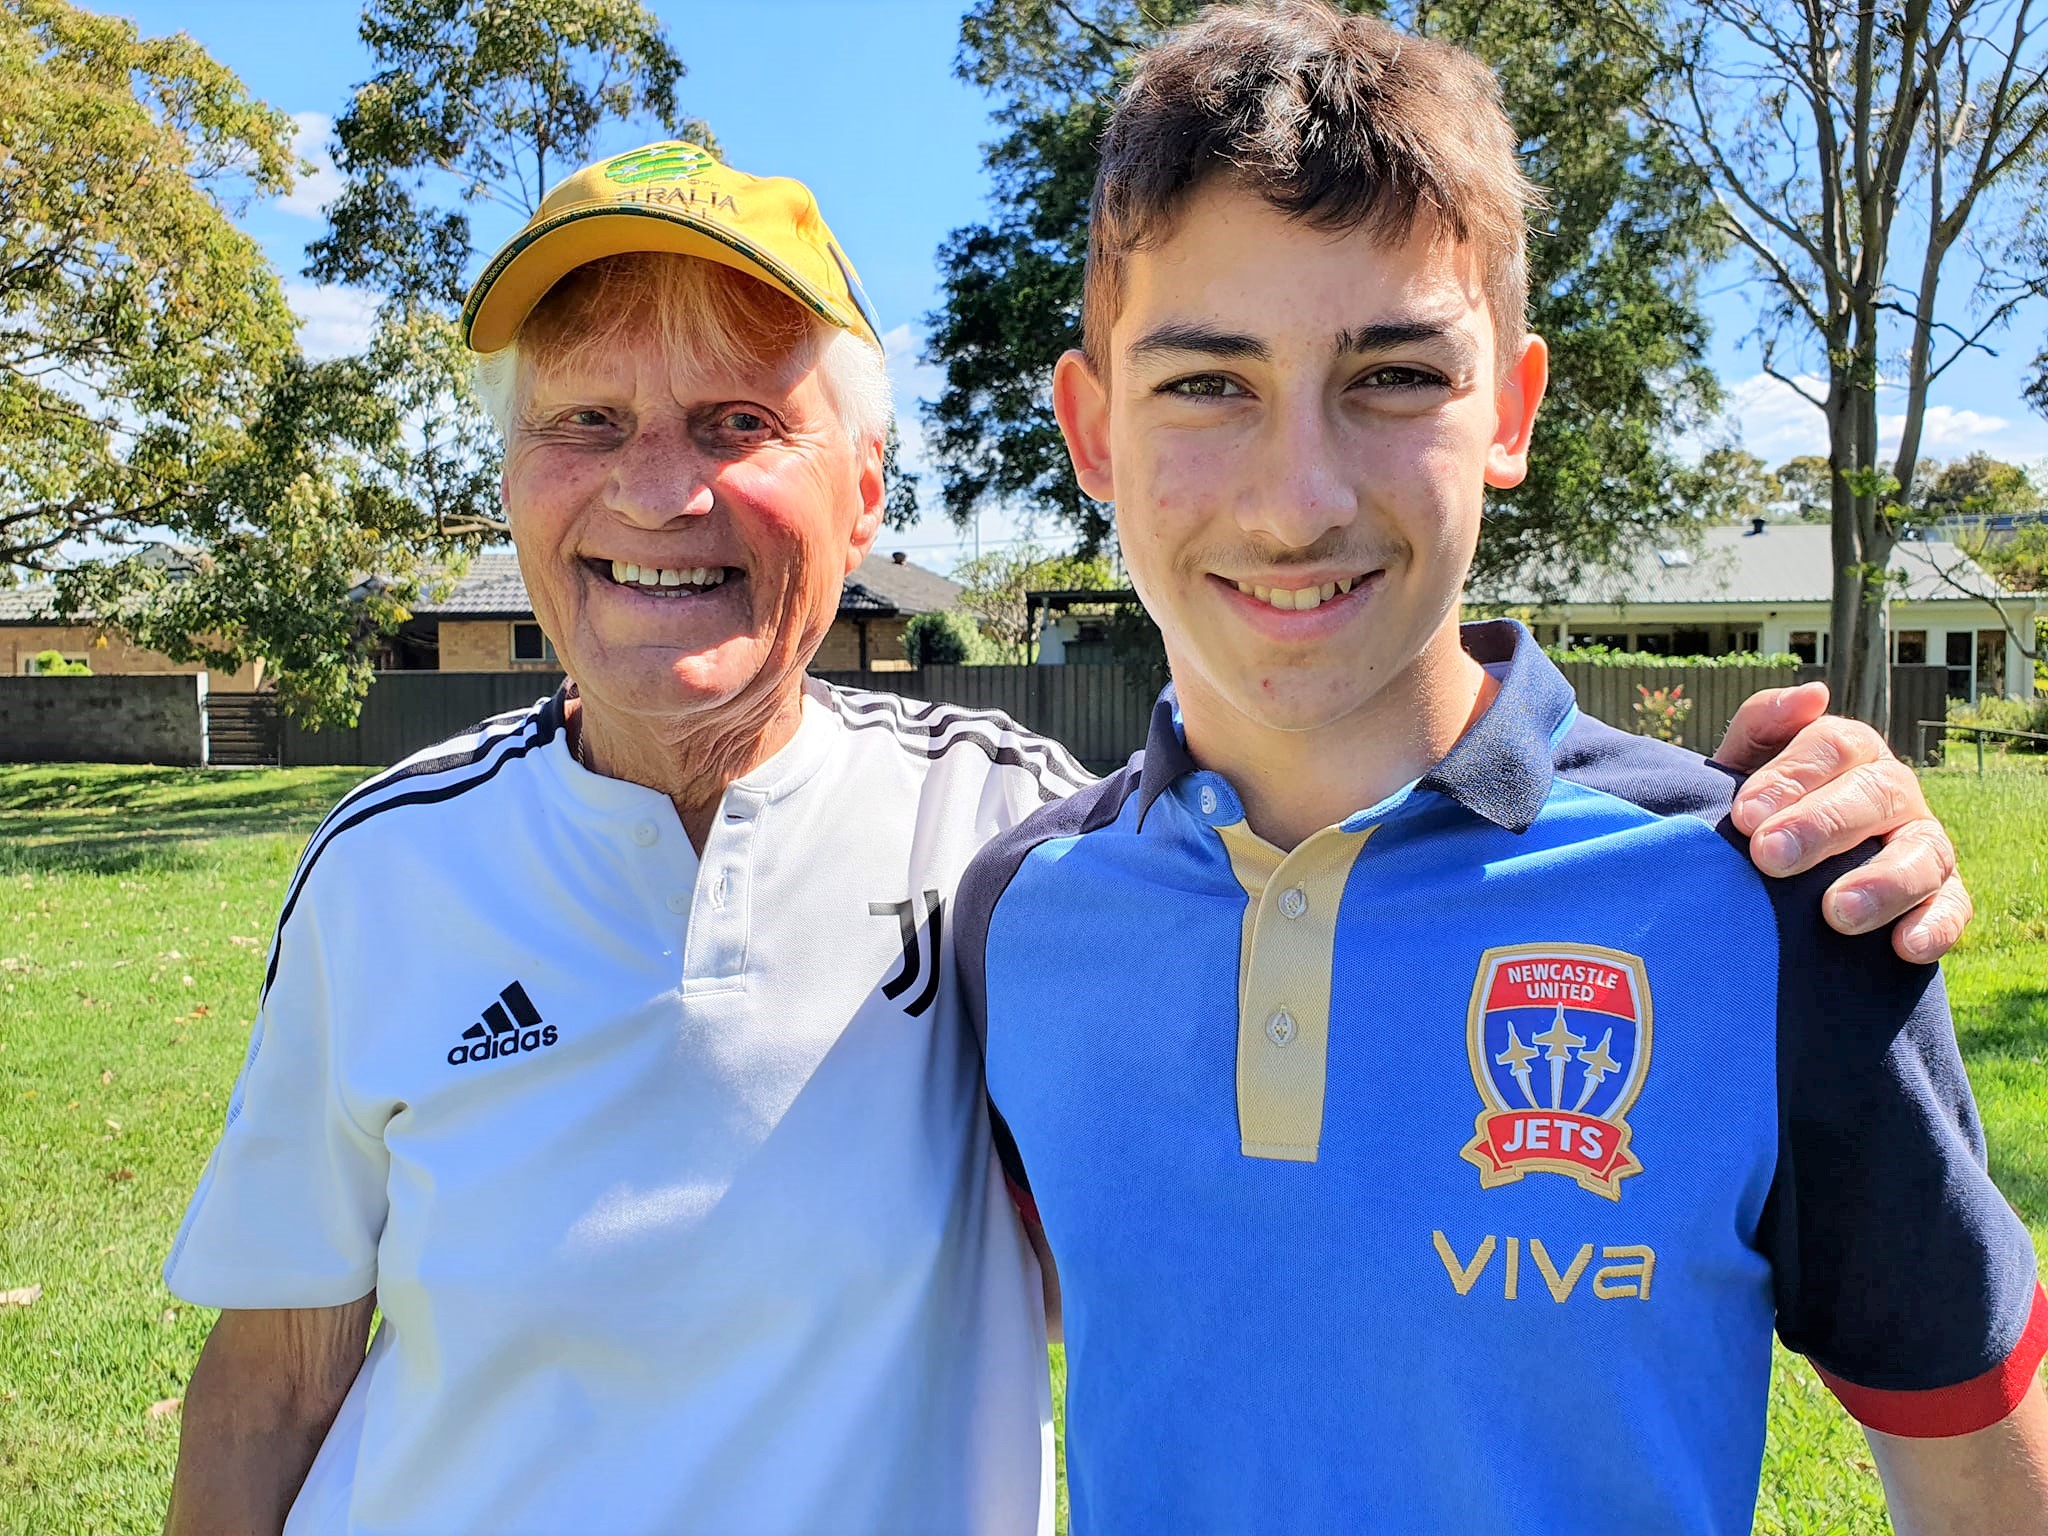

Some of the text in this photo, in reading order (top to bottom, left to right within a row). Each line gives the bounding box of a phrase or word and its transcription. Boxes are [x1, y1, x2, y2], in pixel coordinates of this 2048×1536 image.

[616, 188, 740, 216] TRALIA
[1507, 963, 1619, 990] NEWCASTLE
[1526, 983, 1595, 1002] UNITED
[447, 1025, 558, 1066] adidas
[1502, 1118, 1604, 1160] JETS
